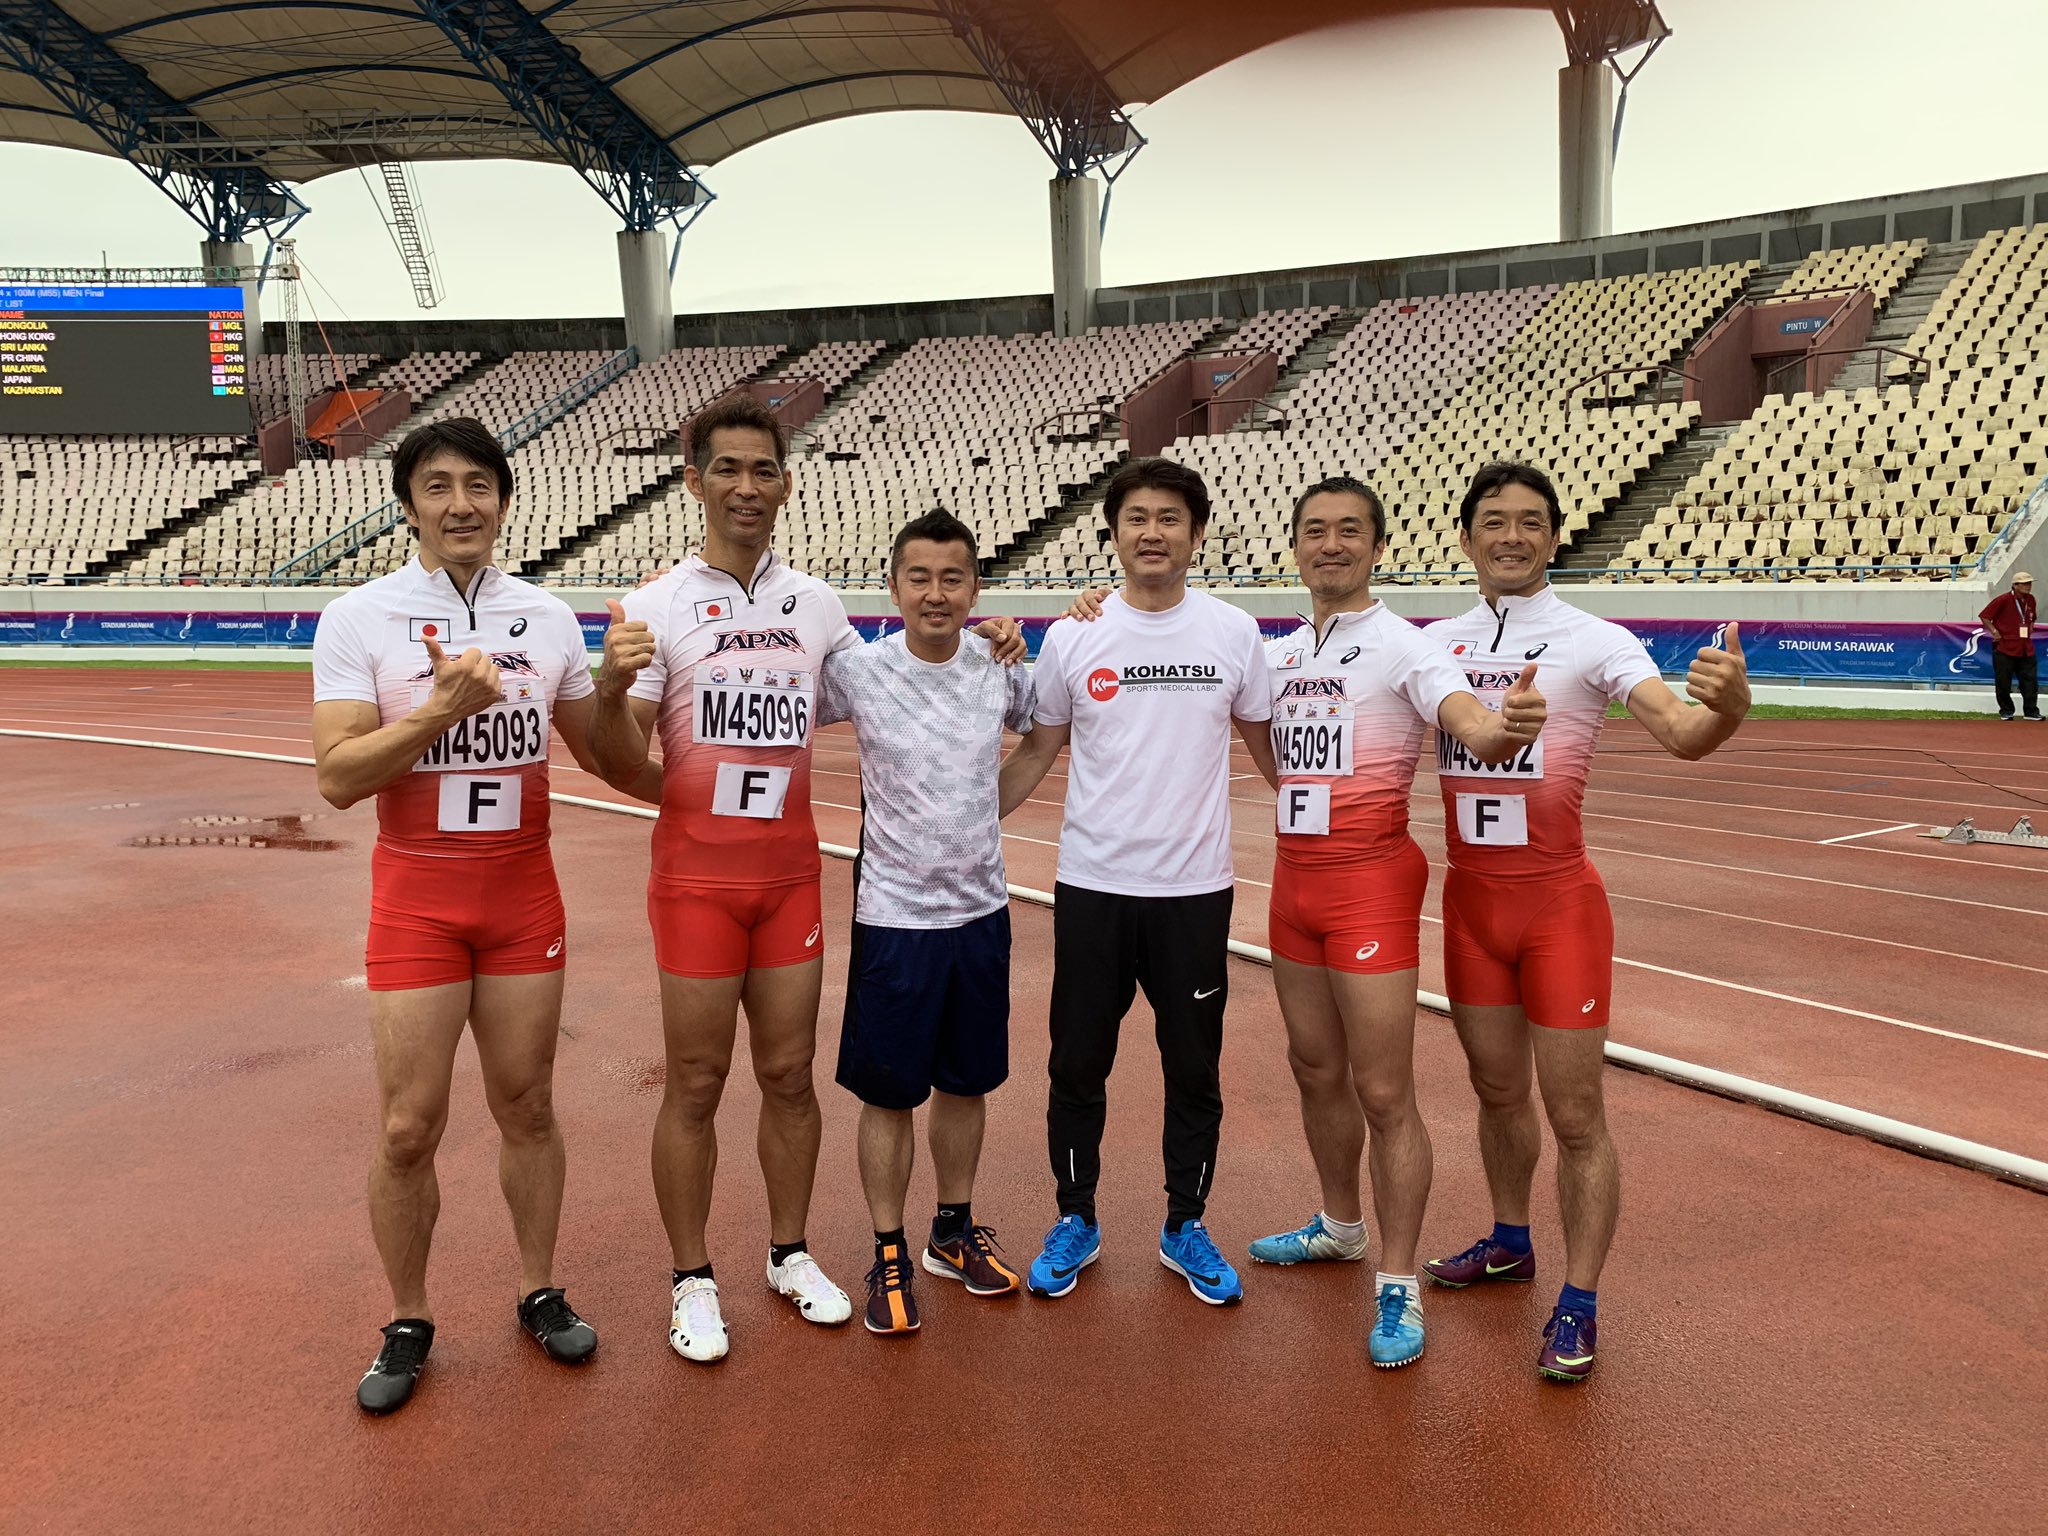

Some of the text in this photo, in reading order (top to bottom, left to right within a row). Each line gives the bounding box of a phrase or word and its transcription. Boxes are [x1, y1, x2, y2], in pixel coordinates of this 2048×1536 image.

[209, 311, 242, 319] NATION
[223, 322, 242, 330] MGL
[1786, 322, 1808, 331] PINTU
[223, 333, 243, 341] HKG
[1, 343, 15, 351] SRI
[1, 354, 44, 362] PR CHINA
[2, 365, 46, 373] MALAYSIA
[224, 365, 244, 373] MAS
[225, 376, 243, 384] JPN
[3, 386, 63, 394] KAZHAKSTAN
[702, 628, 806, 659] JAPAN
[1778, 640, 1894, 653] STADIUM SARAWAK
[1124, 665, 1216, 678] KOHATSU
[1126, 684, 1217, 693] SPORTS MEDICAL LABO
[1276, 677, 1347, 703] JAPAN
[702, 691, 807, 741] M45096
[740, 771, 769, 810] F
[468, 781, 501, 824] F
[1290, 789, 1309, 827] F
[1476, 799, 1500, 837] F
